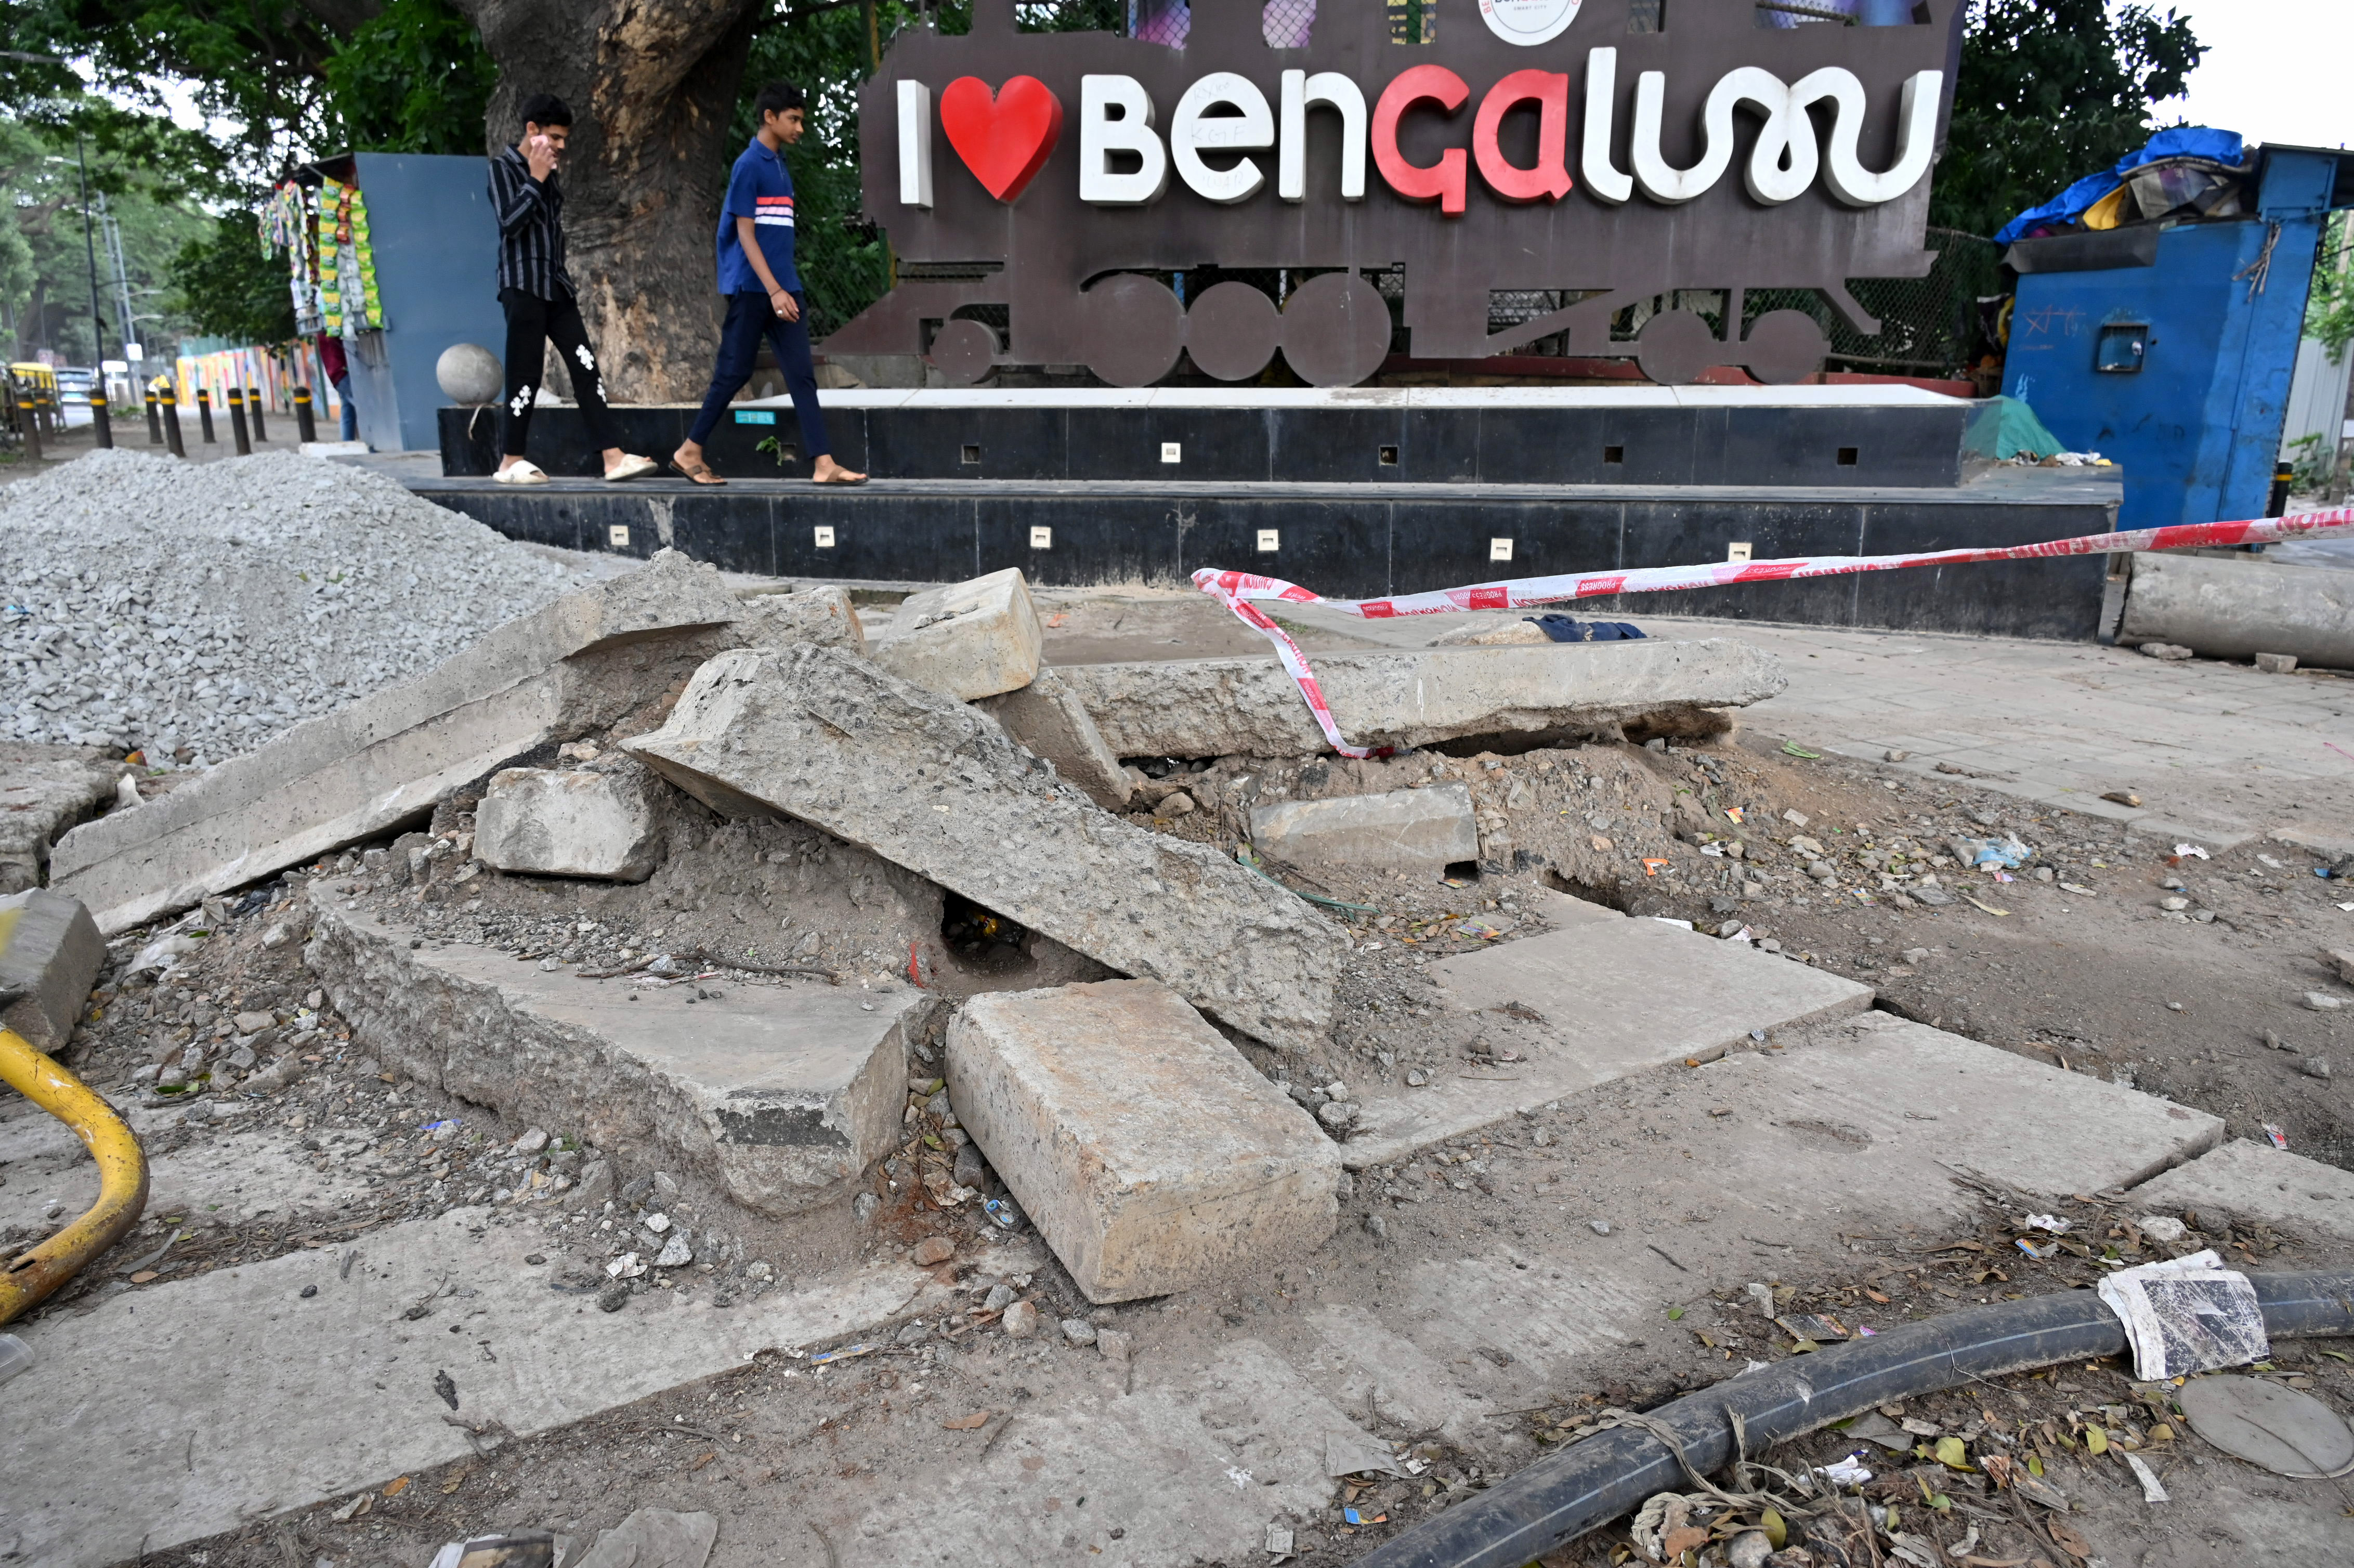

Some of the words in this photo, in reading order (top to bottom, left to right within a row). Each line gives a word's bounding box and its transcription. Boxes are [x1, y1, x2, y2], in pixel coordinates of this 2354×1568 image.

[897, 80, 932, 207] I
[1580, 580, 1616, 592] PROGRESS
[1472, 590, 1502, 600] PROGRESS
[1240, 607, 1265, 628] PROGRESS
